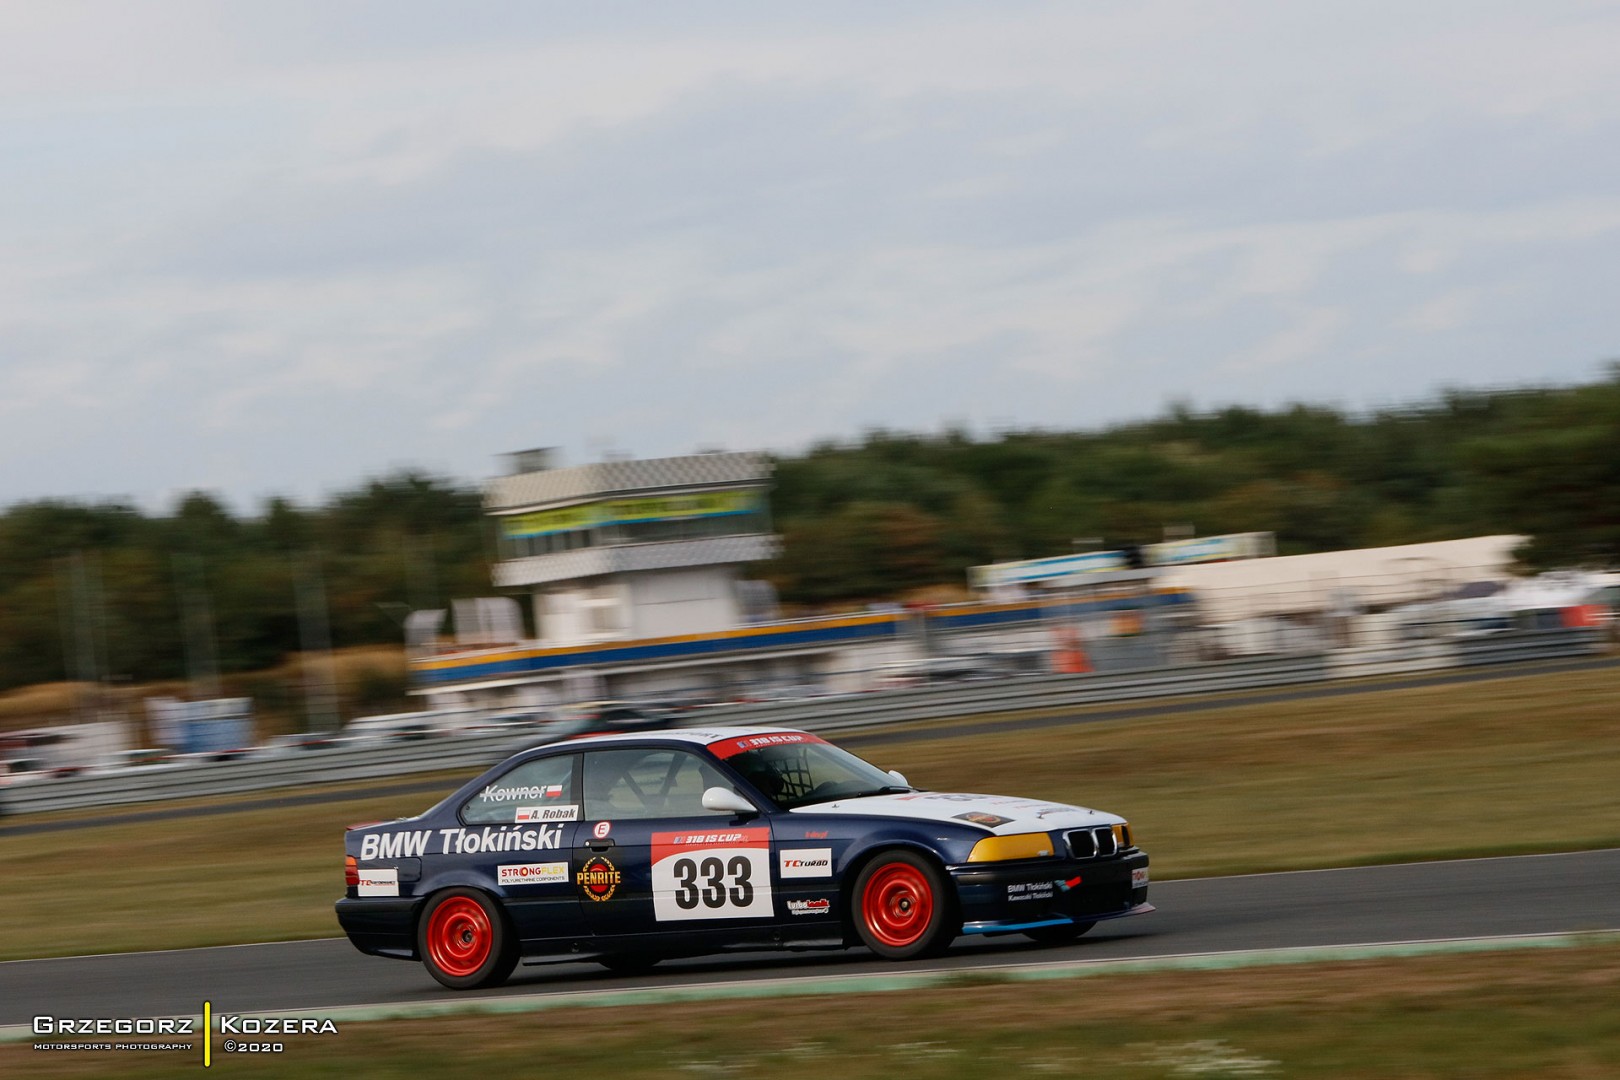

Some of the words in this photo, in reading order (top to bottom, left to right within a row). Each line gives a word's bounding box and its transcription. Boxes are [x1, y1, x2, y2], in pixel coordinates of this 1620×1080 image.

[530, 810, 540, 819] A.
[542, 808, 576, 819] Robak
[360, 829, 432, 861] BMW
[439, 823, 565, 855] Tłokiński
[706, 834, 718, 843] IS
[718, 833, 742, 842] CUP
[501, 865, 565, 877] STRONGFLEX
[576, 870, 621, 885] PENRITE
[673, 856, 754, 910] 333
[1008, 884, 1025, 893] BMW
